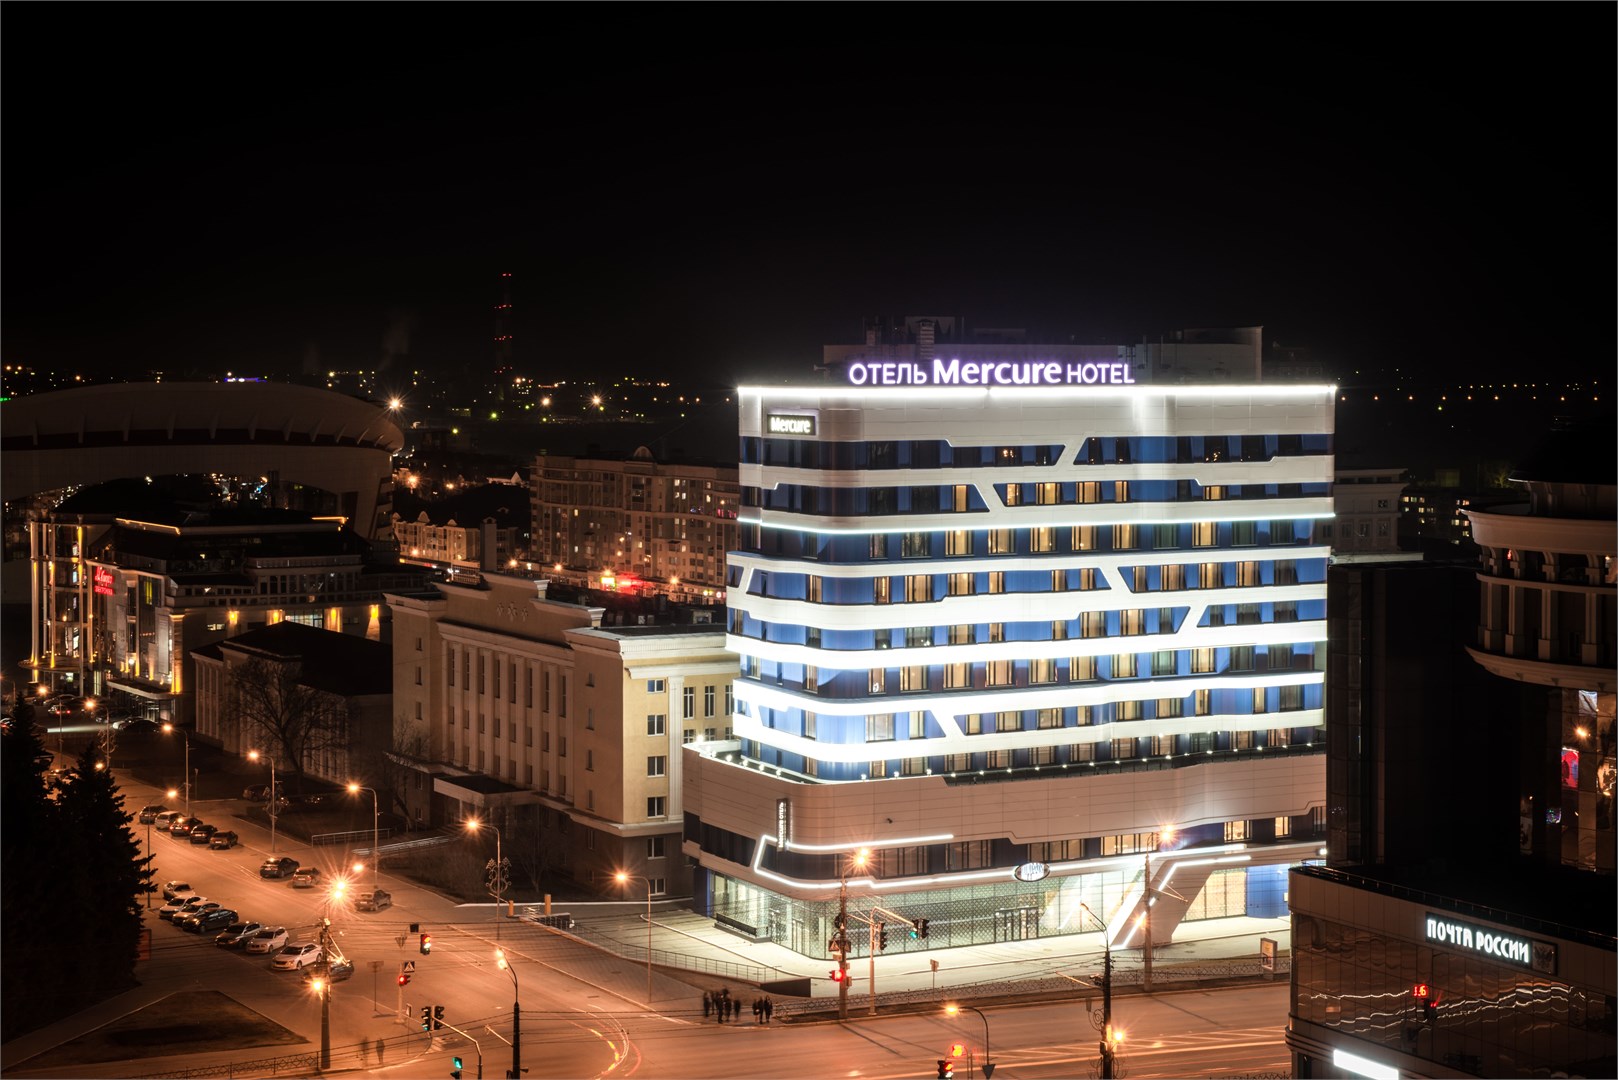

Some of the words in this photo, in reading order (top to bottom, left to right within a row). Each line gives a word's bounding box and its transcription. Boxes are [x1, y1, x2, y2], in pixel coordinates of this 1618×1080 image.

[849, 363, 927, 385] ОТЕЛЬ
[933, 359, 1061, 385] Mercure
[1067, 363, 1135, 384] HOTEL
[771, 417, 811, 434] Mercure
[1427, 919, 1473, 948] ПОЧТА
[1476, 931, 1530, 964] РОССИИ
